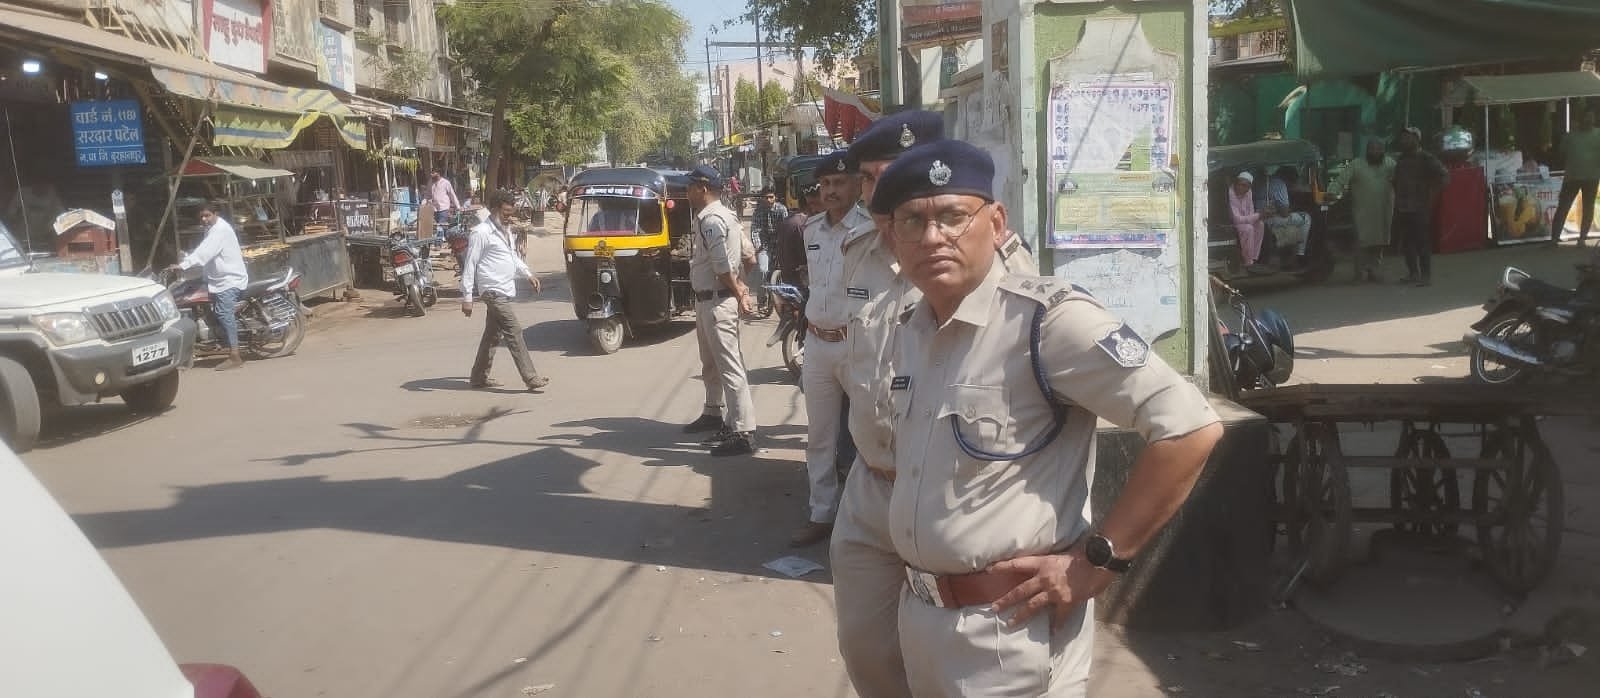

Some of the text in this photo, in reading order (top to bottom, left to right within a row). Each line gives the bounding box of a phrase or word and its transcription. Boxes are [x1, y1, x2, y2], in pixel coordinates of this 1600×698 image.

[74, 106, 97, 124] वार्ड
[118, 109, 136, 121] (18)
[78, 124, 139, 144] सरदार पटेल
[136, 348, 165, 362] 1277
